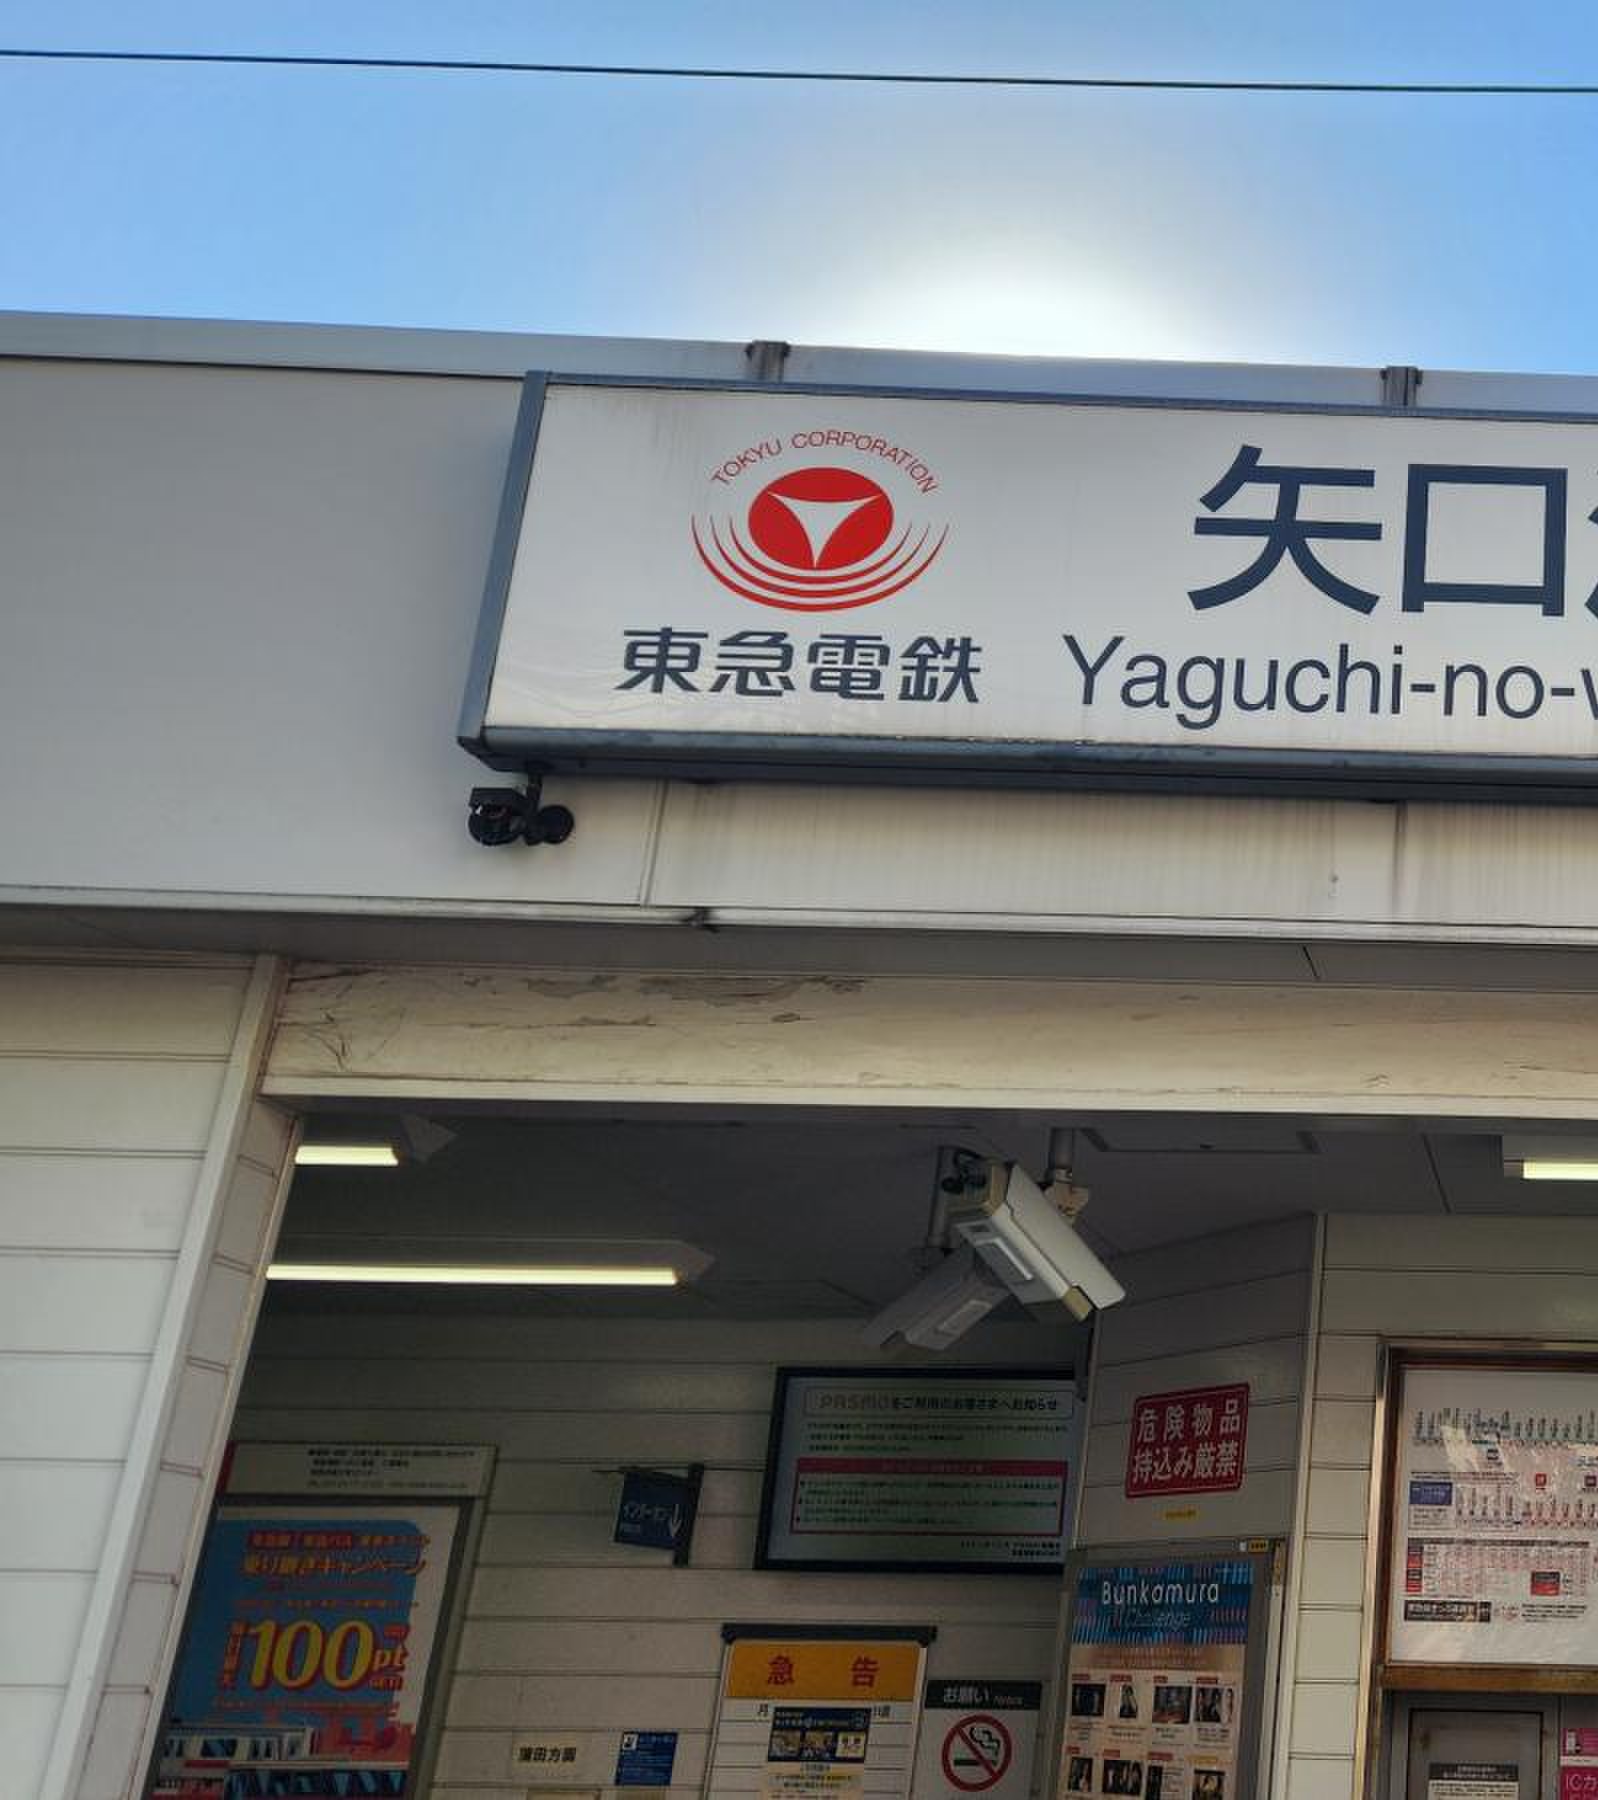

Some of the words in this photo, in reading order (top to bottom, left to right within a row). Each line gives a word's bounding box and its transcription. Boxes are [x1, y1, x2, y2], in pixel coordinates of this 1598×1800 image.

[711, 438, 783, 488] TOKYU
[791, 429, 939, 495] CORPORATION
[613, 626, 984, 704] 東急電鉄
[1137, 1399, 1241, 1443] 危険物品
[1132, 1440, 1239, 1484] 持込み厳禁
[1102, 1580, 1219, 1606] Bunkamura
